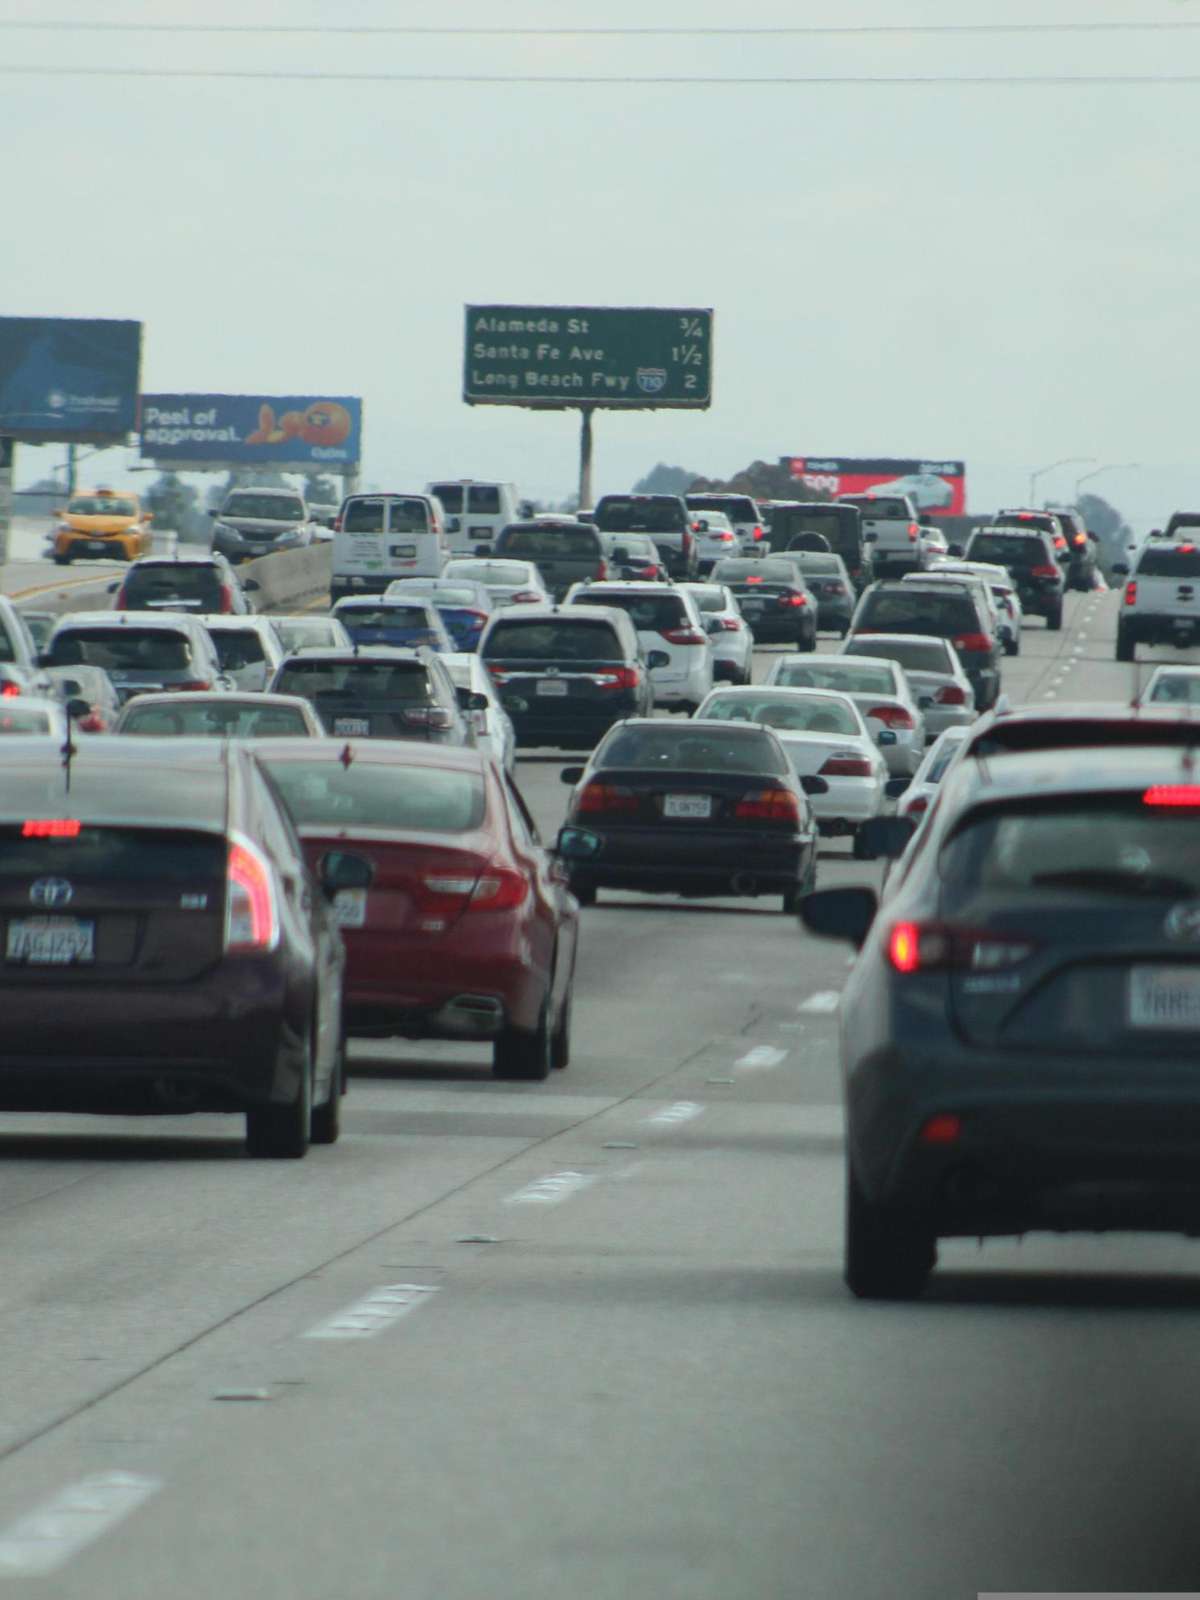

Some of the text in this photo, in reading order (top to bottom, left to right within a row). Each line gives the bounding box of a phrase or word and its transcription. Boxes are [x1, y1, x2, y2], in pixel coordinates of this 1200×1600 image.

[475, 317, 590, 334] Alameda St
[473, 343, 604, 360] Santa Fe Ave
[472, 370, 630, 391] Long Beach Fwy
[684, 374, 697, 389] 2
[144, 407, 217, 425] Peel of
